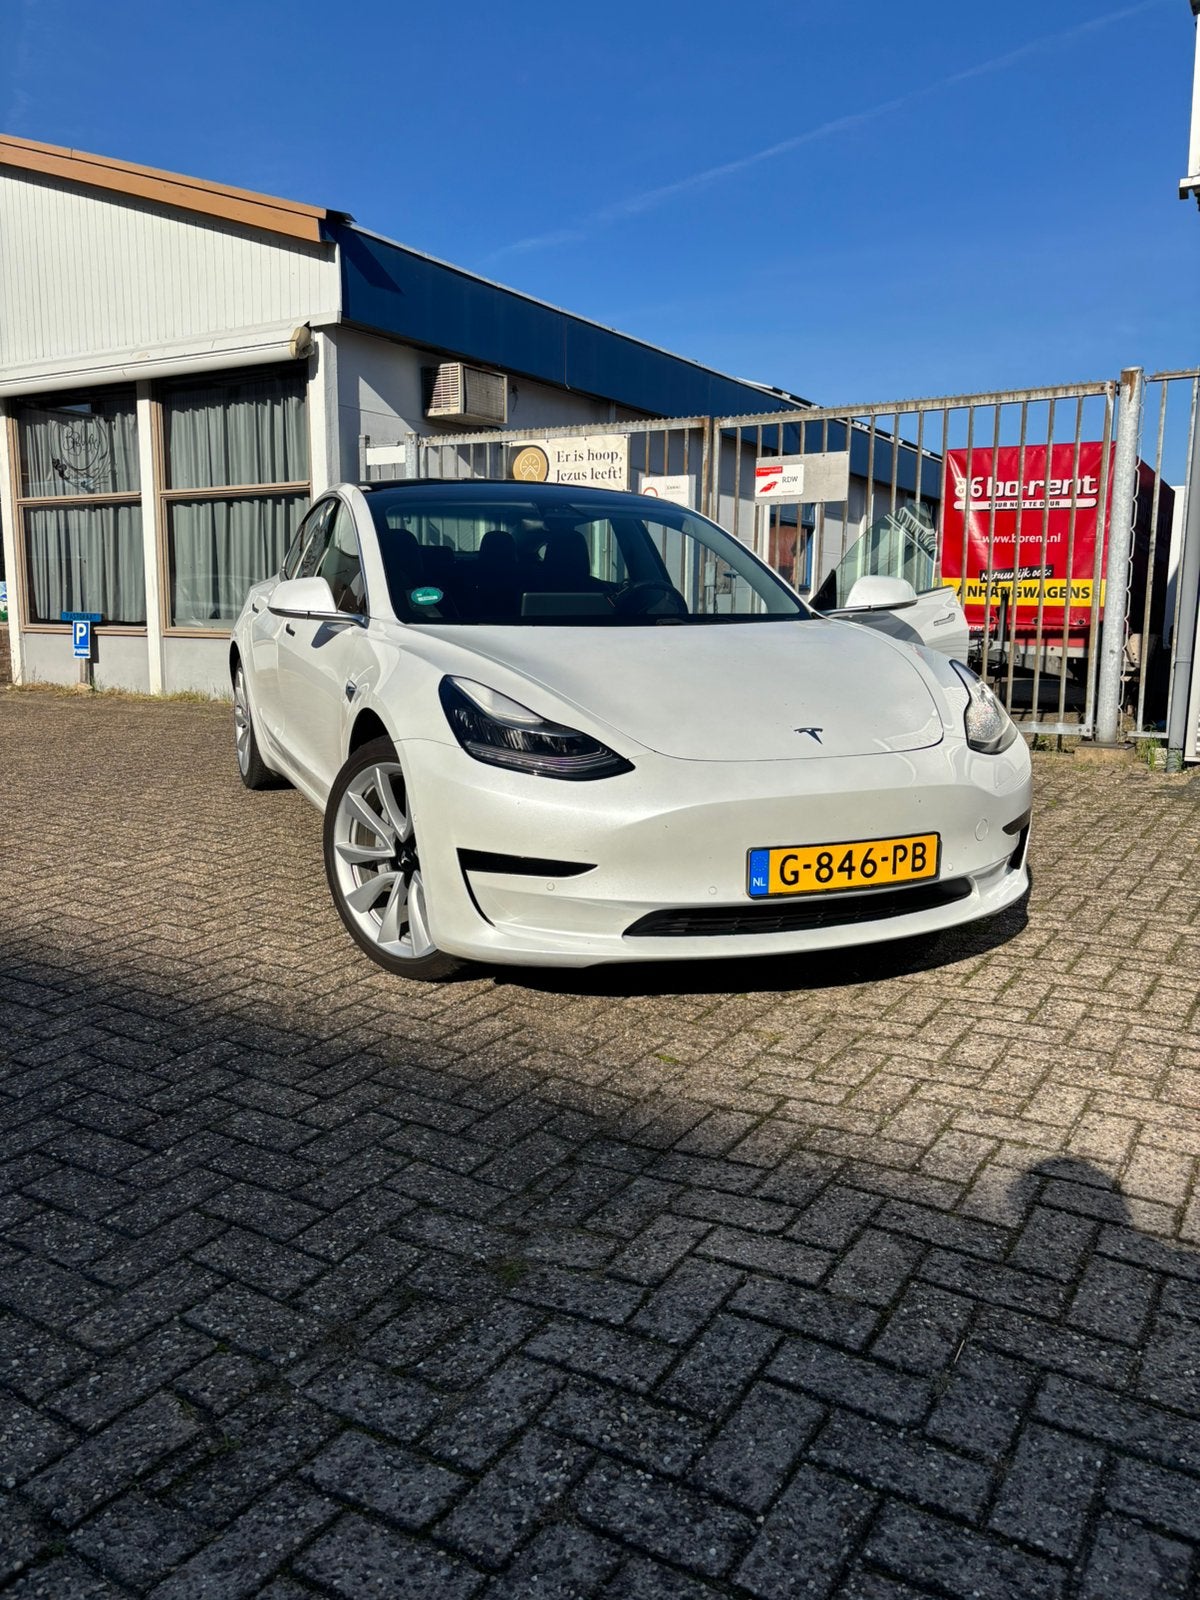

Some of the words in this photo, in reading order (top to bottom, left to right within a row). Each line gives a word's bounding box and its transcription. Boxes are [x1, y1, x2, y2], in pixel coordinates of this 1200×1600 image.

[557, 451, 571, 463] Er
[574, 450, 584, 462] is
[587, 448, 623, 464] hoop,
[556, 469, 587, 483] Jezus
[590, 465, 622, 480] leeft!
[781, 476, 799, 484] RDW
[982, 532, 1062, 544] www.boren.nl
[980, 567, 1031, 582] Ntuurijk
[76, 623, 87, 645] P
[752, 877, 767, 887] NL
[779, 842, 927, 886] G-846-PB
